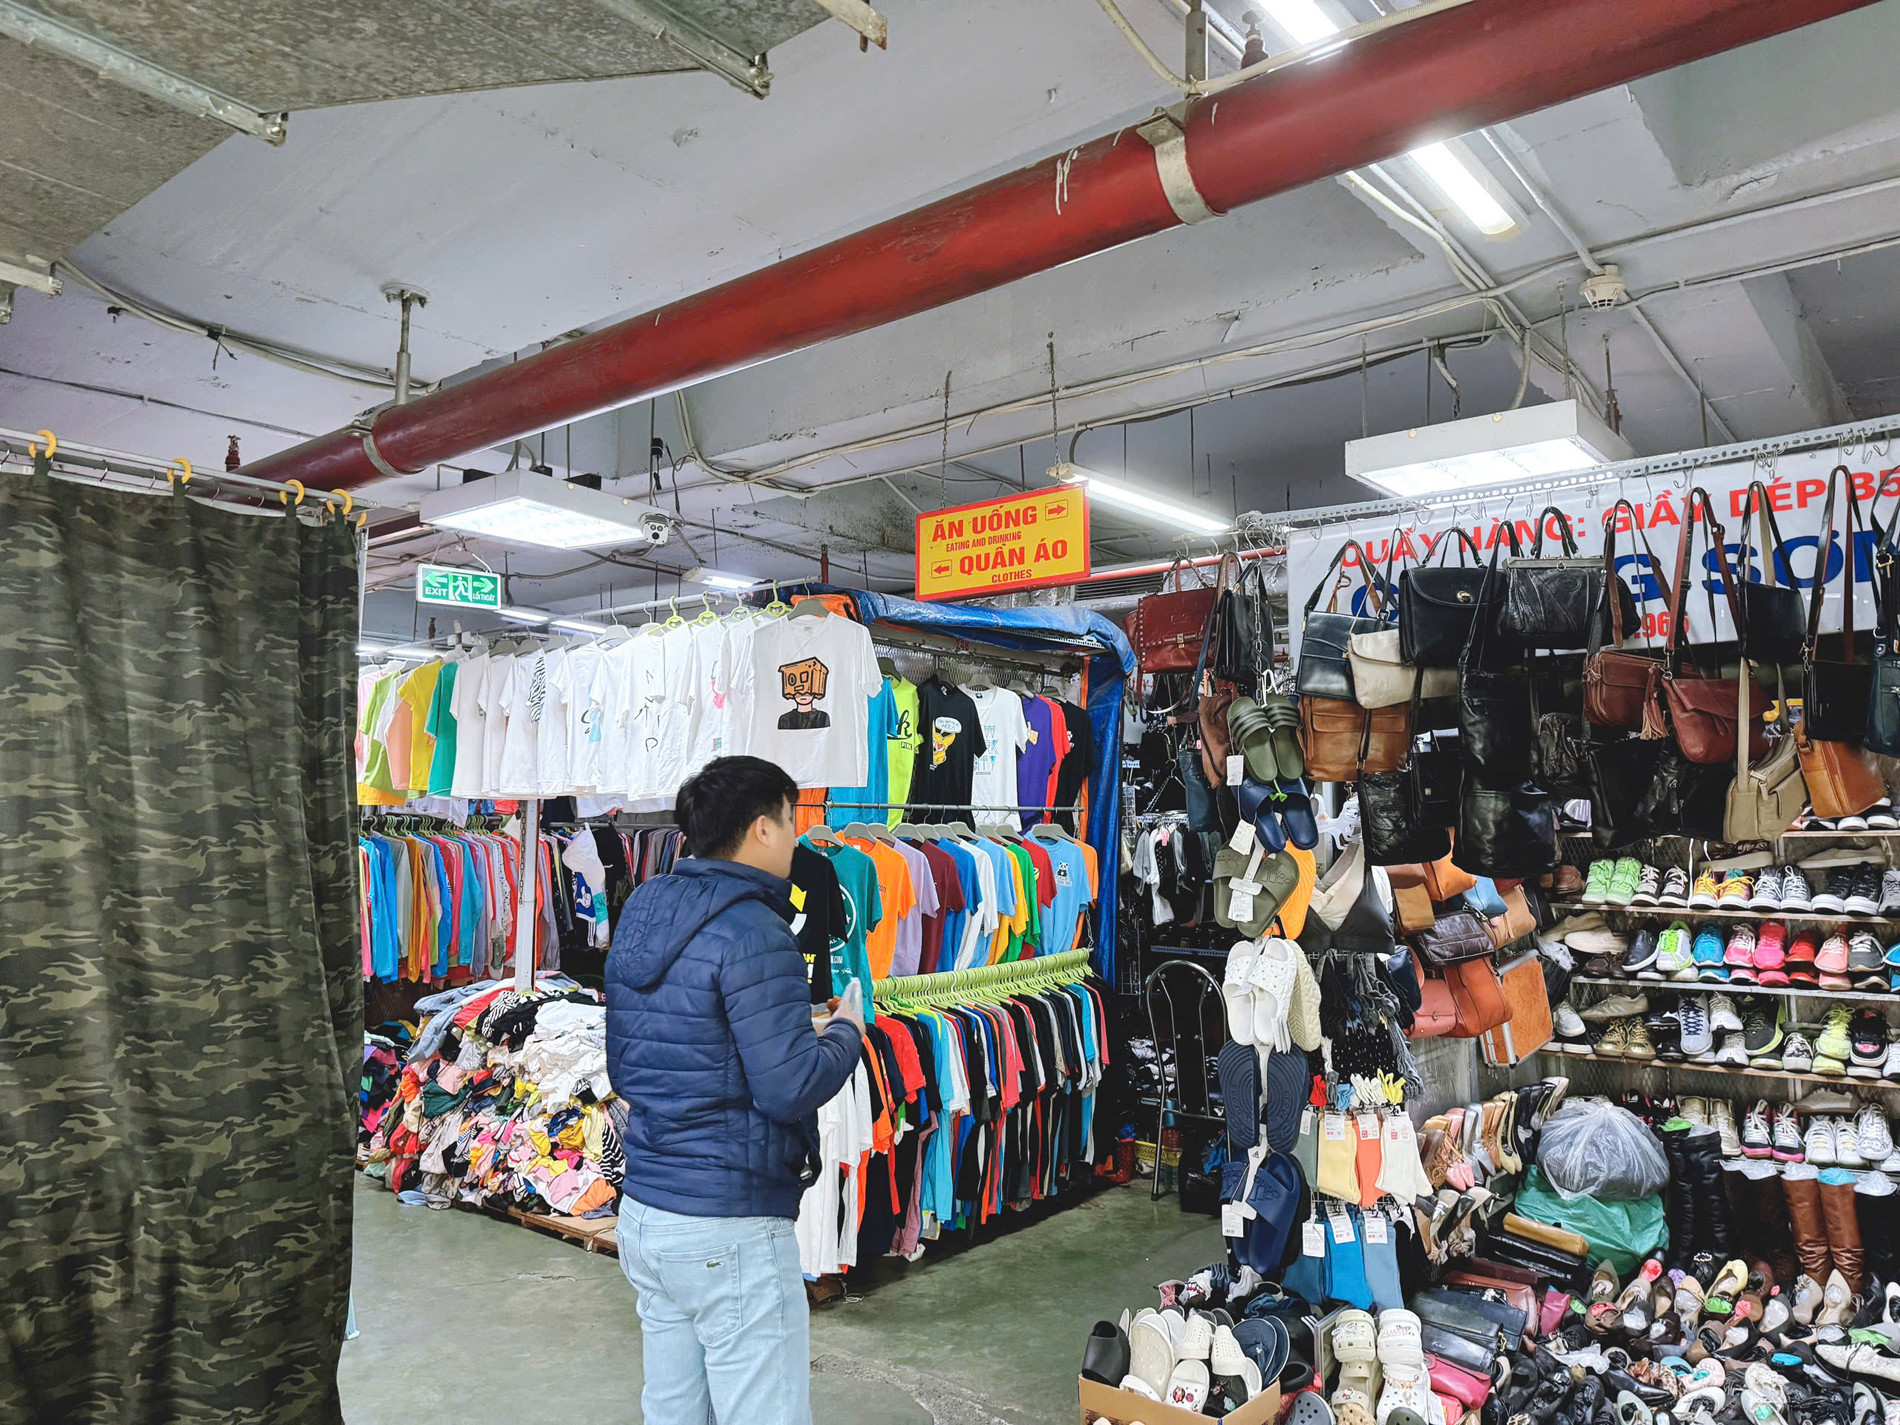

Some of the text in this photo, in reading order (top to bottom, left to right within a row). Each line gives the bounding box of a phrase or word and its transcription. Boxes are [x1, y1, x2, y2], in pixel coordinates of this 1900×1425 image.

[932, 505, 1037, 543] ĂN UỐNG
[1458, 514, 1587, 553] HÀNG:
[1602, 490, 1712, 534] GIẦY
[1729, 476, 1827, 518] DÉP
[946, 531, 1022, 552] EATING AND DRINKING
[959, 538, 1068, 576] QUẦN ÁO
[991, 569, 1032, 584] CLOTHES
[425, 587, 448, 597] EXIT
